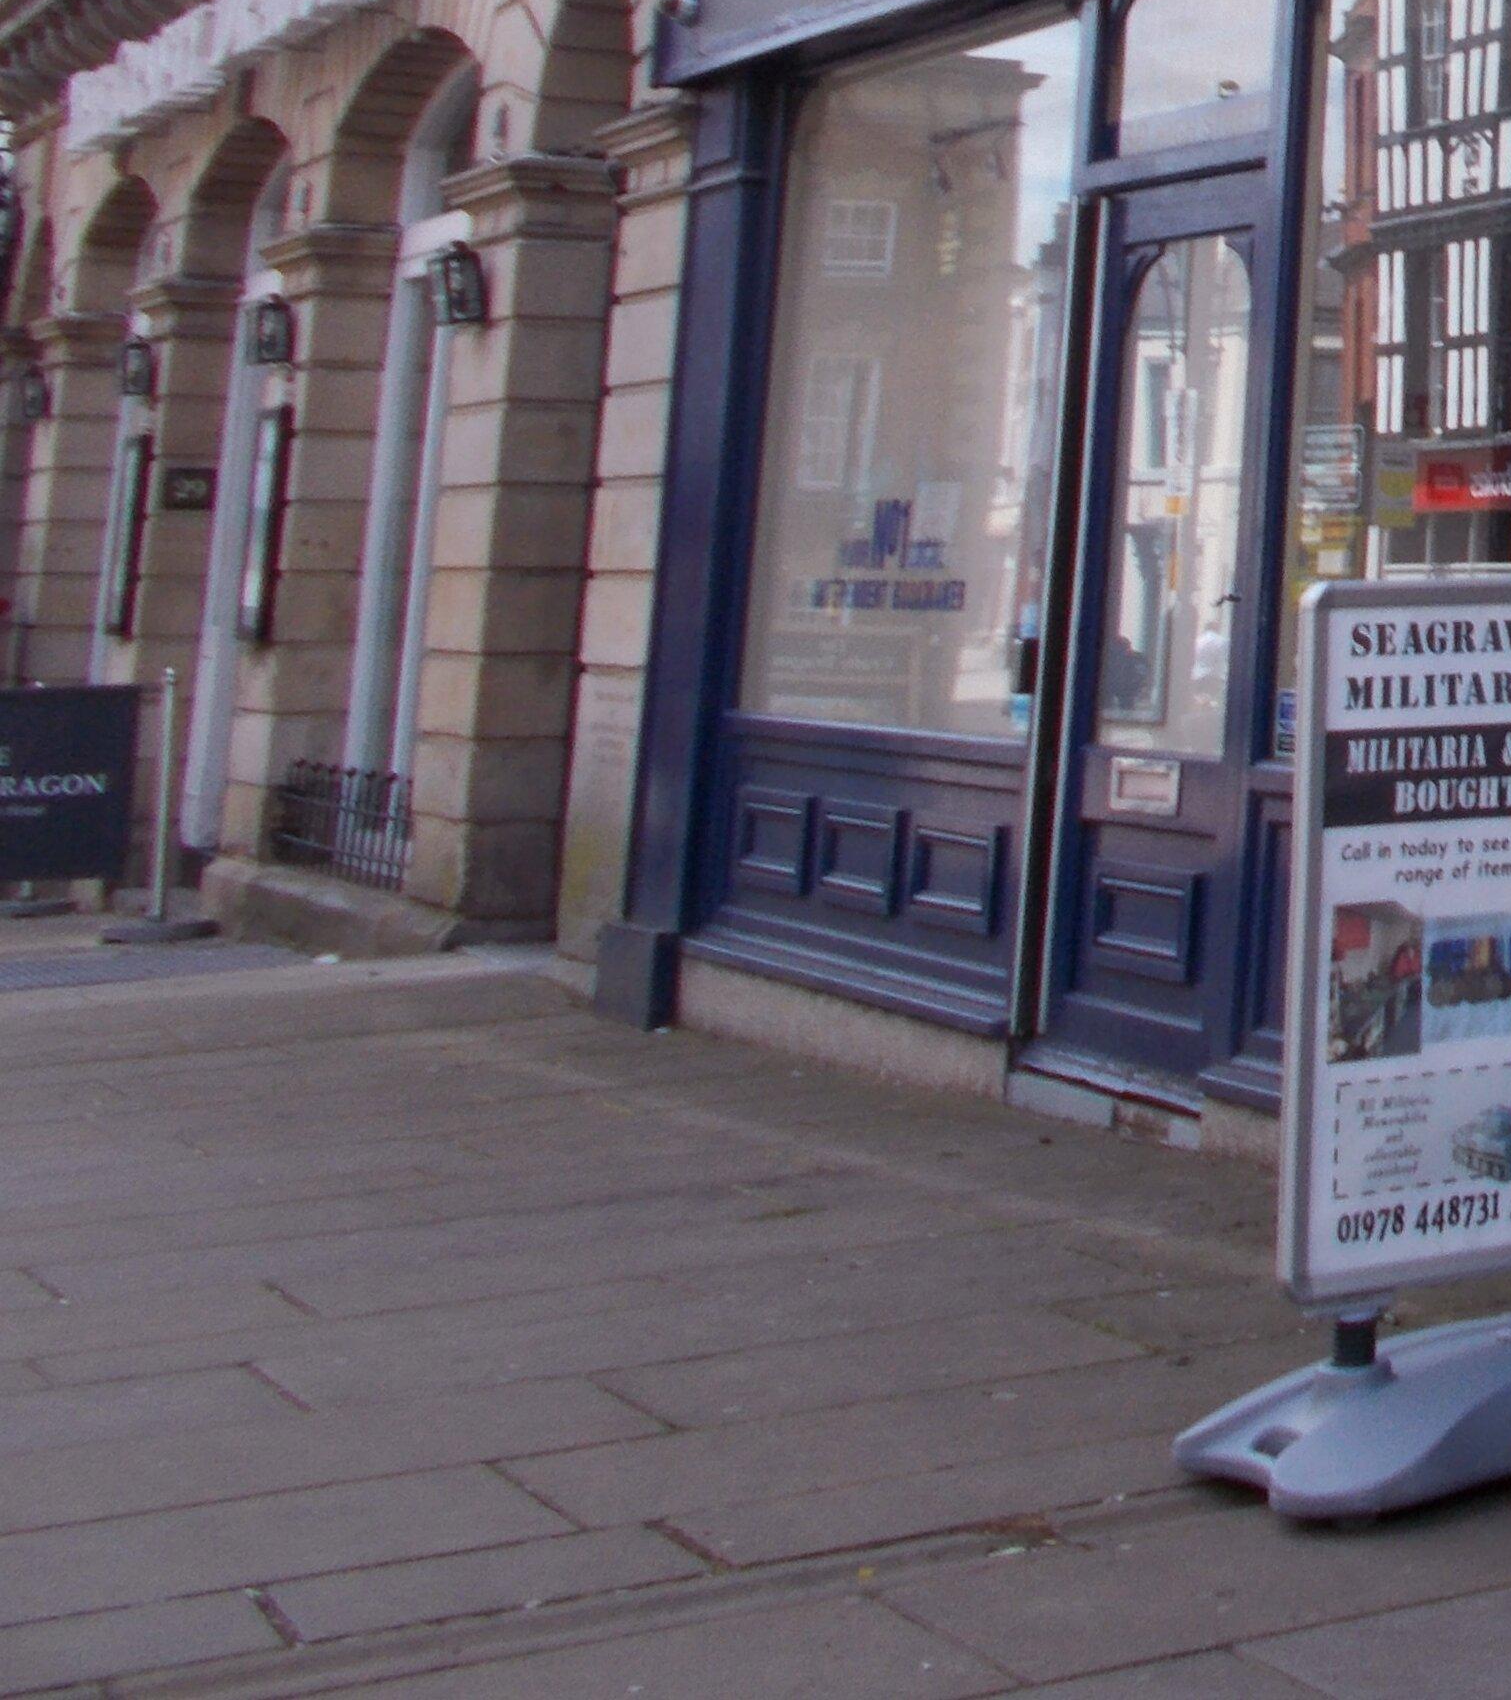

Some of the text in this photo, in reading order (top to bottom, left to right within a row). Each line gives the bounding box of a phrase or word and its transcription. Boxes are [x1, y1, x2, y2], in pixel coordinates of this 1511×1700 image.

[1346, 732, 1487, 775] MILITARIA
[1340, 840, 1372, 862] Call
[1377, 841, 1393, 859] in
[1401, 837, 1448, 859] today
[1457, 837, 1475, 853] to
[1482, 836, 1510, 851] see
[1394, 866, 1445, 887] range
[1451, 859, 1471, 880] of
[1336, 1205, 1405, 1245] 01978
[1415, 1192, 1500, 1237] 448731
